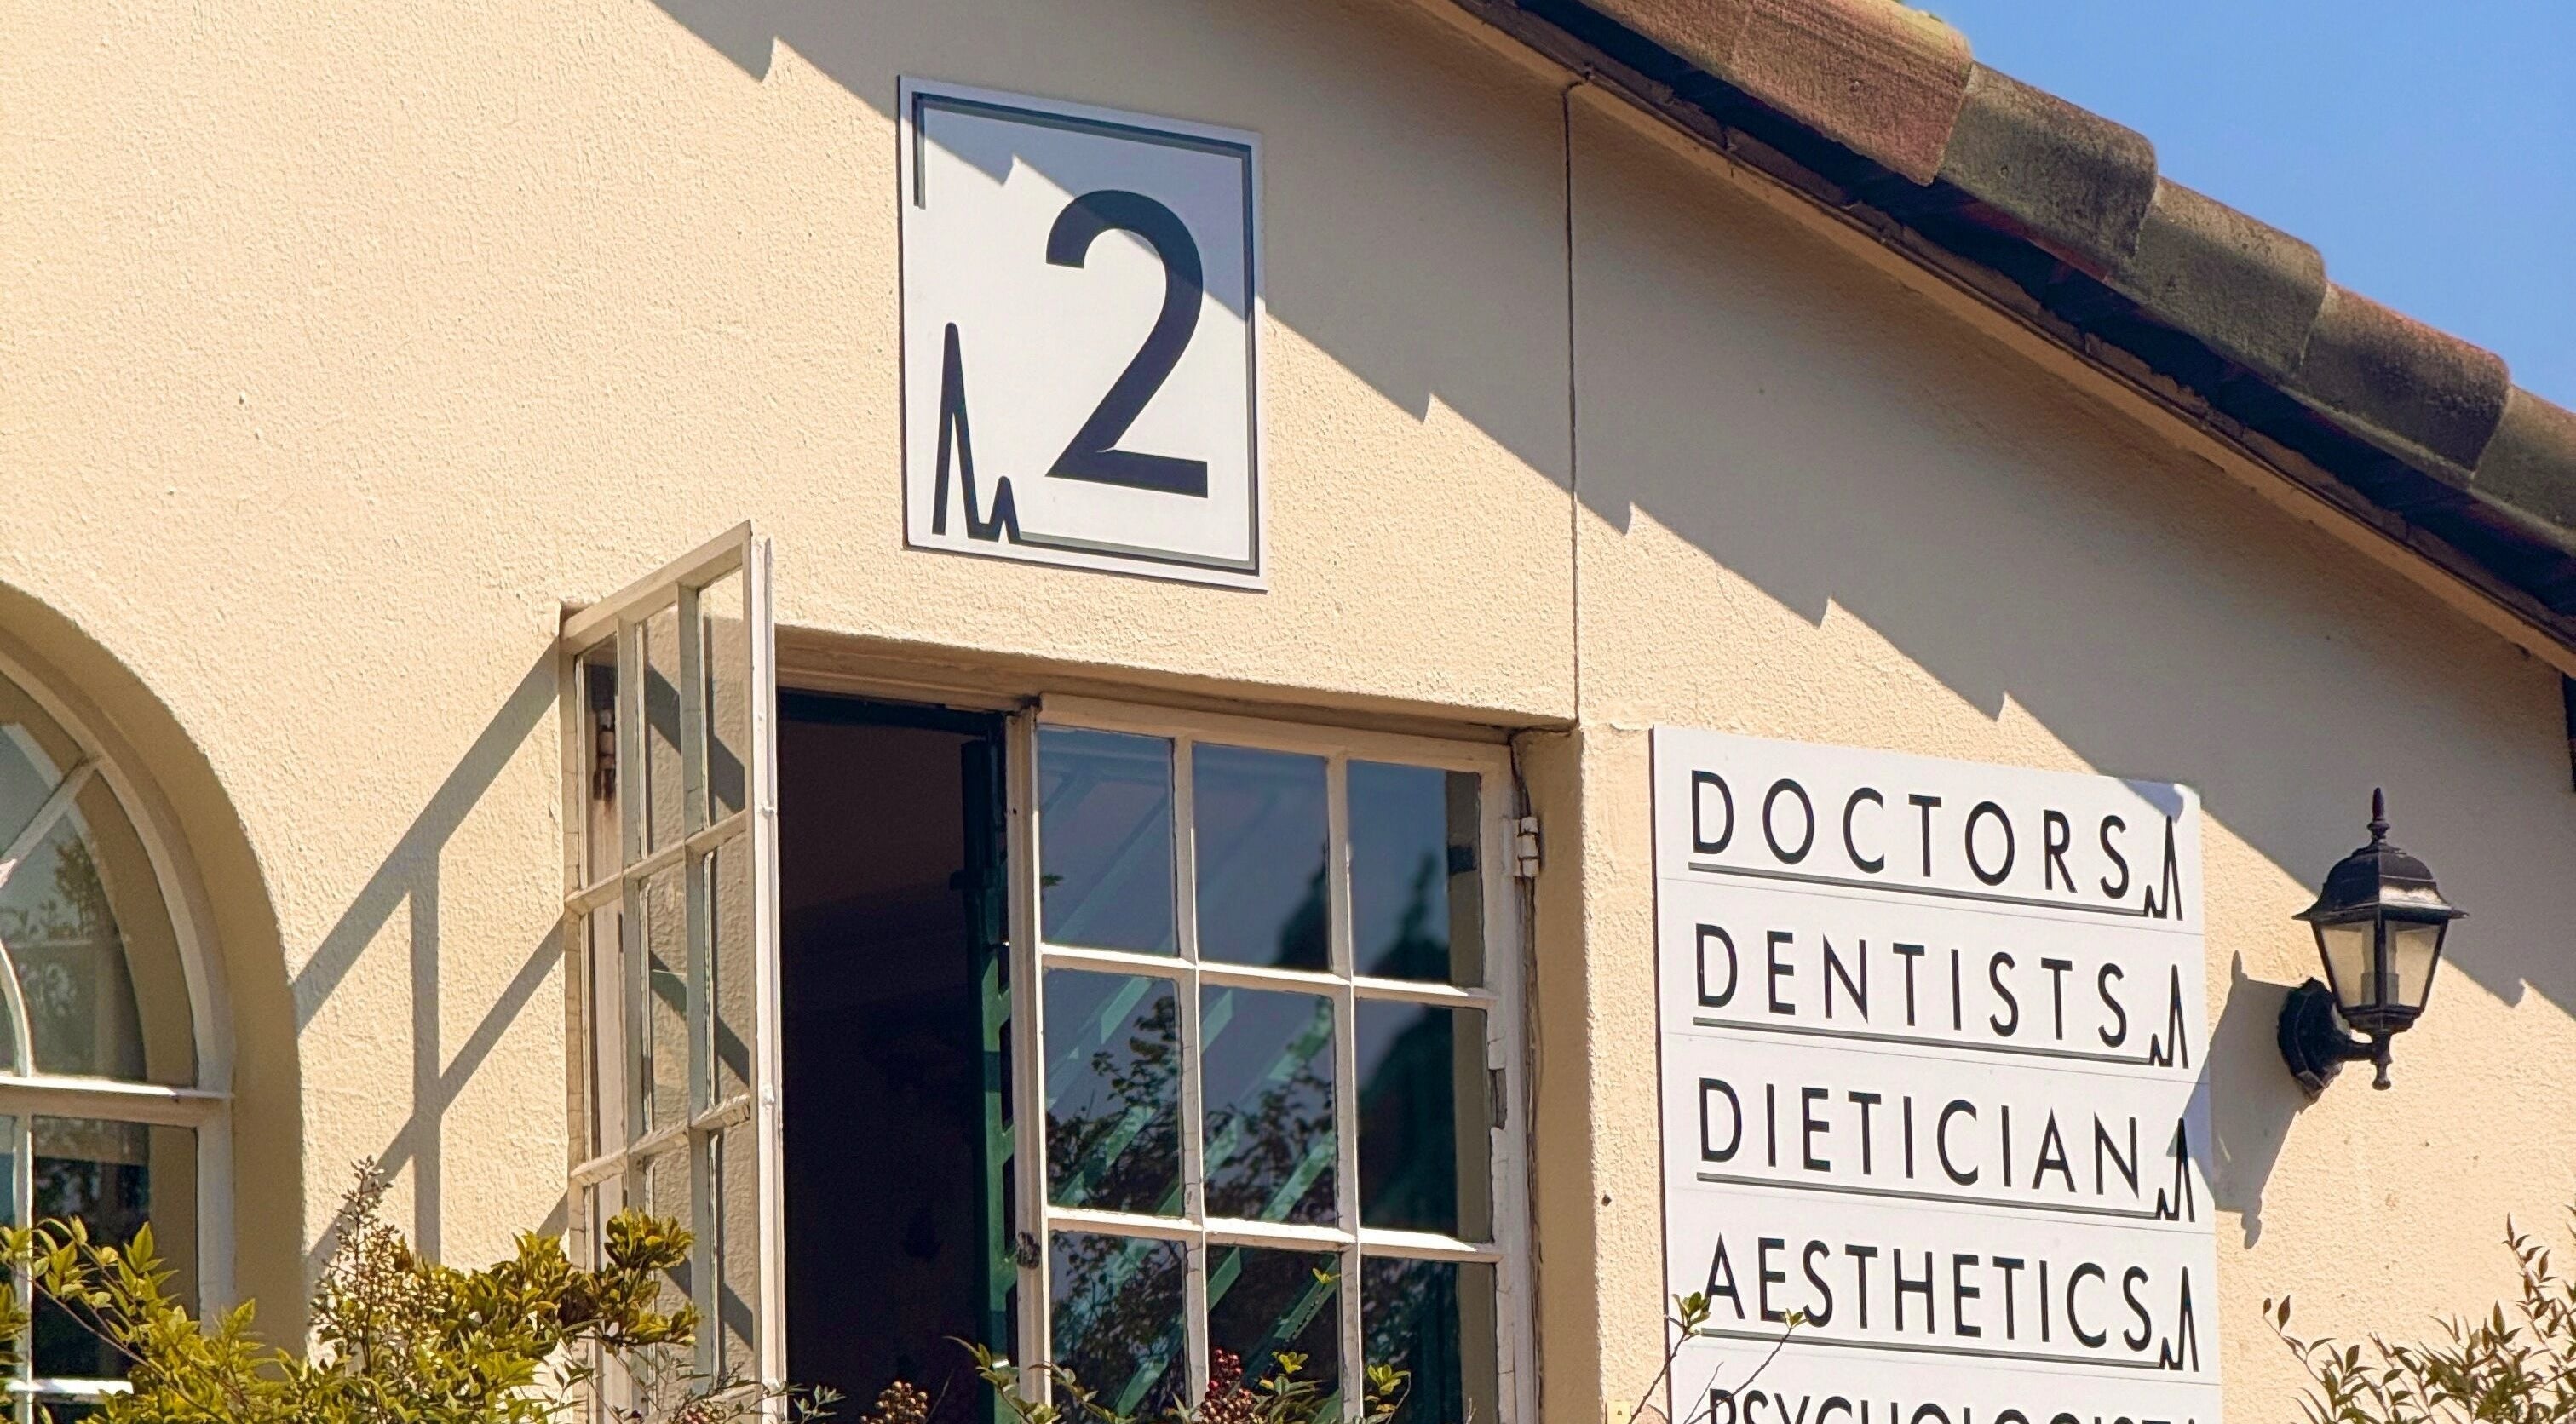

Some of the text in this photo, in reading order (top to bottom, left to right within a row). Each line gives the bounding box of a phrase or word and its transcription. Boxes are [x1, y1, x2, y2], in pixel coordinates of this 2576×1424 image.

[1045, 189, 1208, 499] 2
[1691, 769, 2129, 899] DOCTORS
[1695, 922, 2128, 1048] DENTISTS
[1699, 1077, 2140, 1199] DIETICIAN
[1704, 1232, 2153, 1352] AESTHETICS
